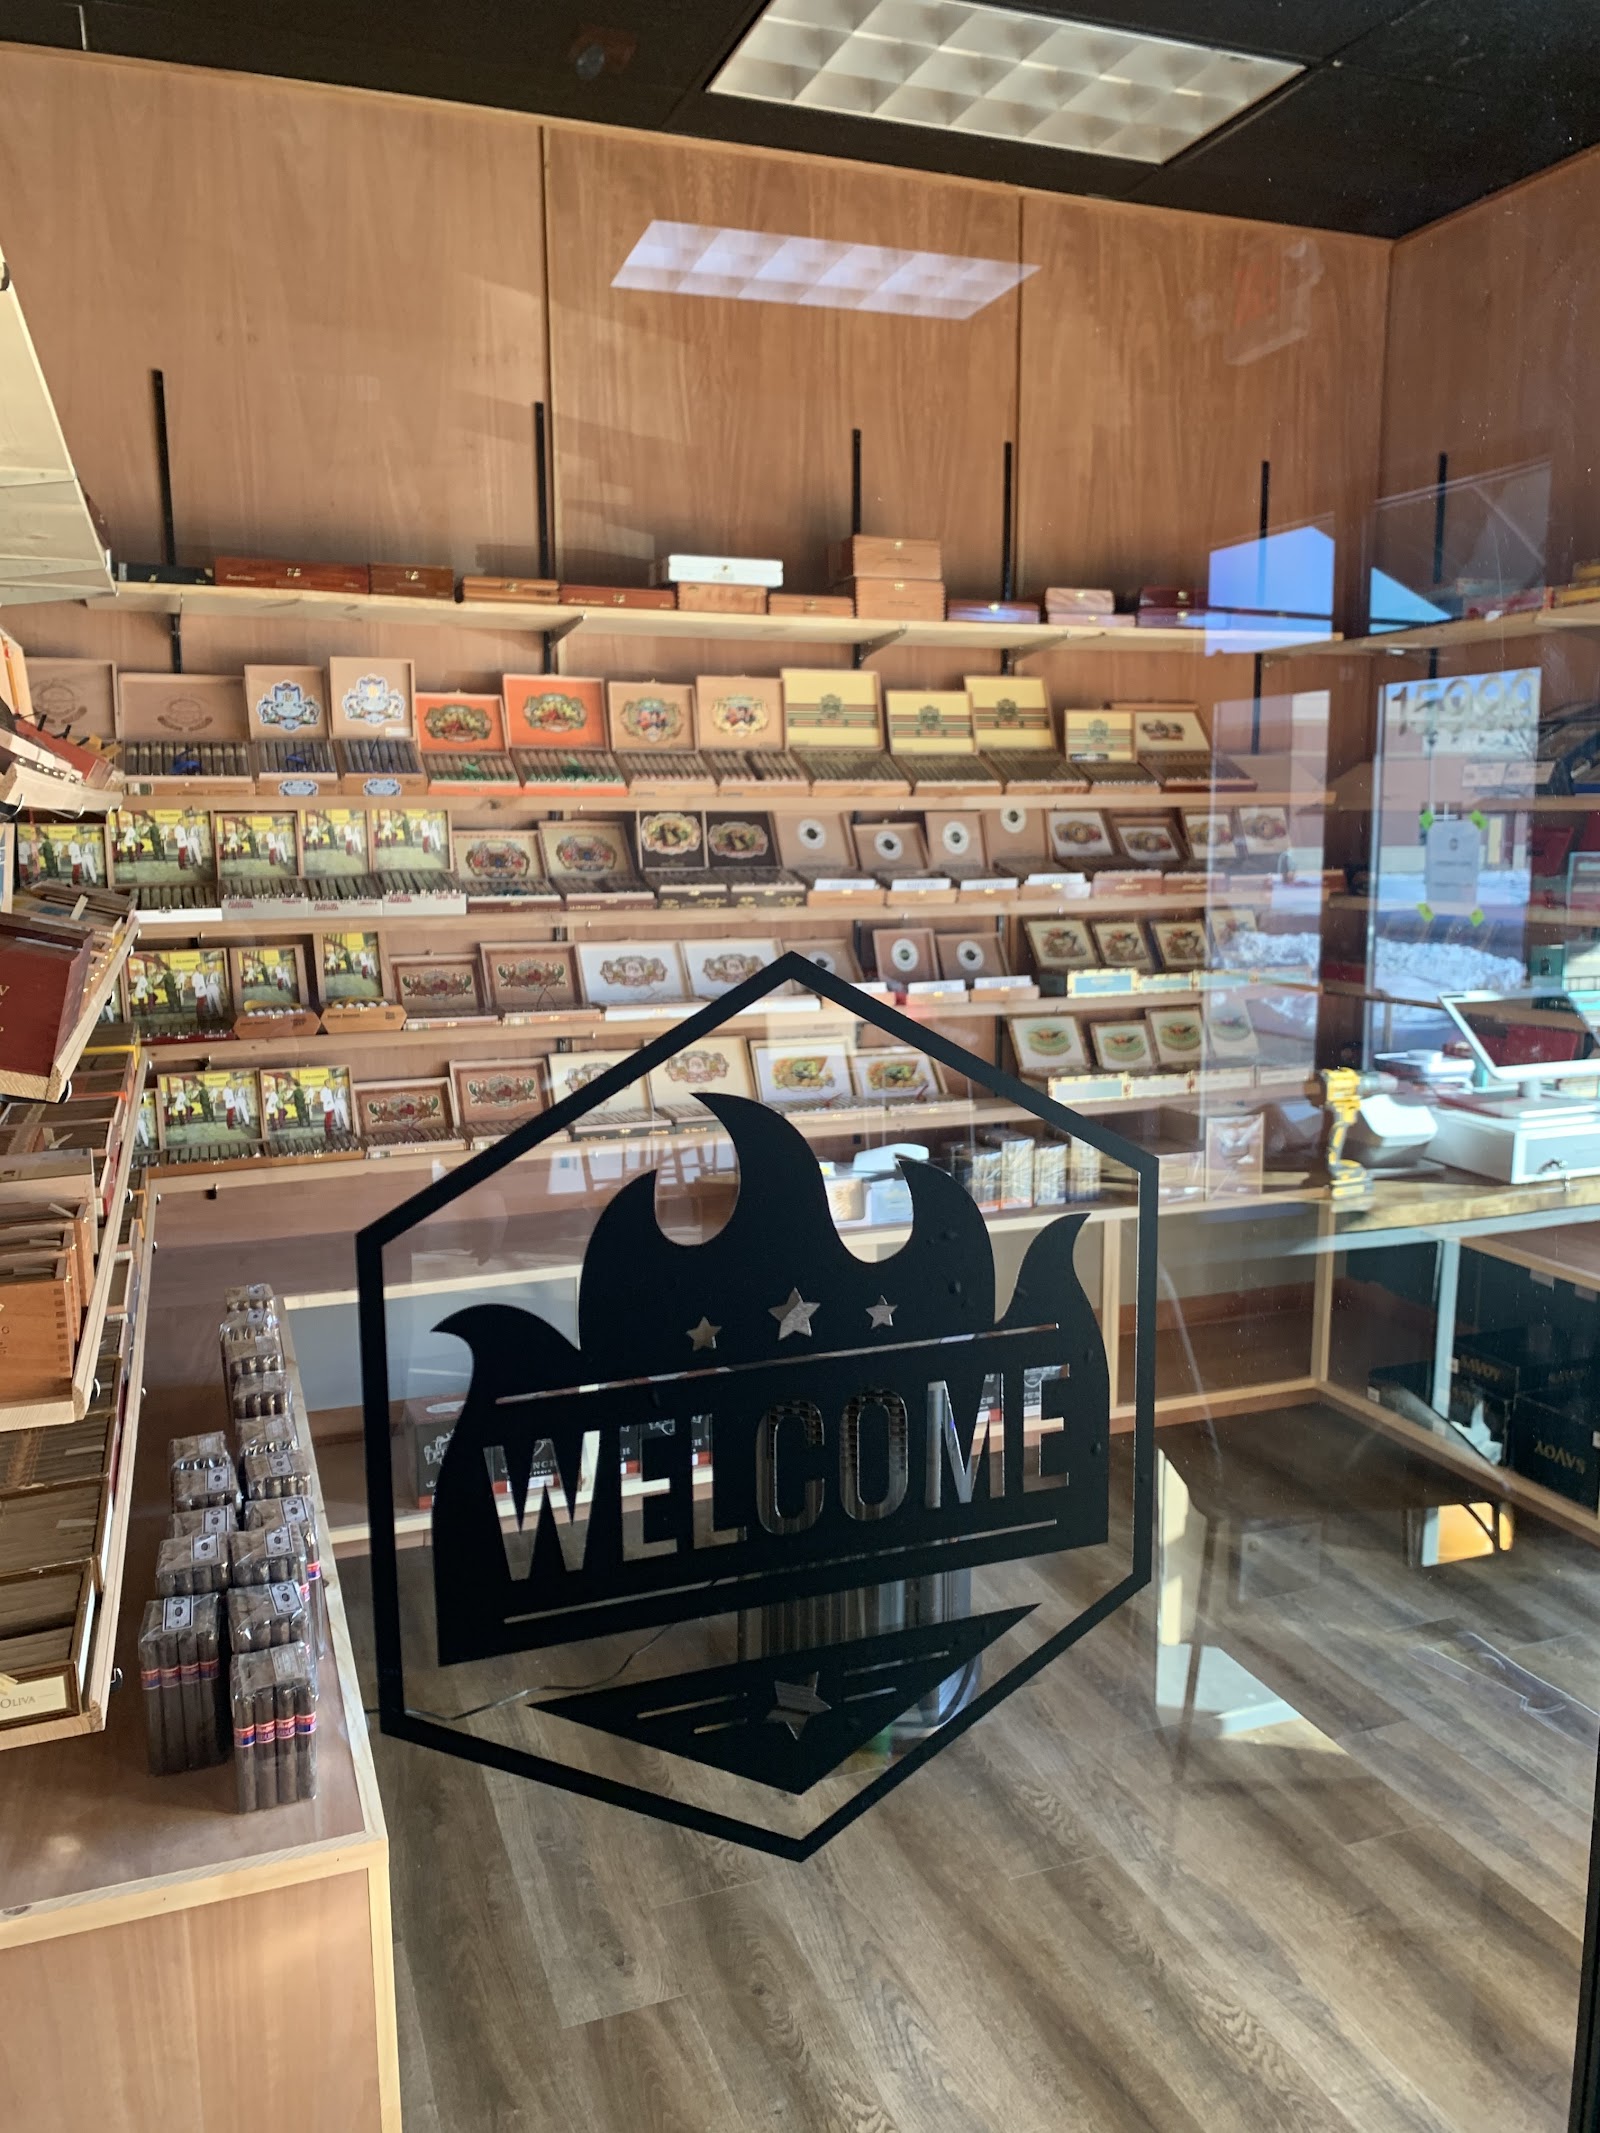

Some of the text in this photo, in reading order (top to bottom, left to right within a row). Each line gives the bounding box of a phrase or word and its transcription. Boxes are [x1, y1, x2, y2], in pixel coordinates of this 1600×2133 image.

[482, 1362, 1071, 1580] WELCOME
[1534, 1440, 1587, 1476] SAVOY
[0, 1696, 36, 1709] OLIVA
